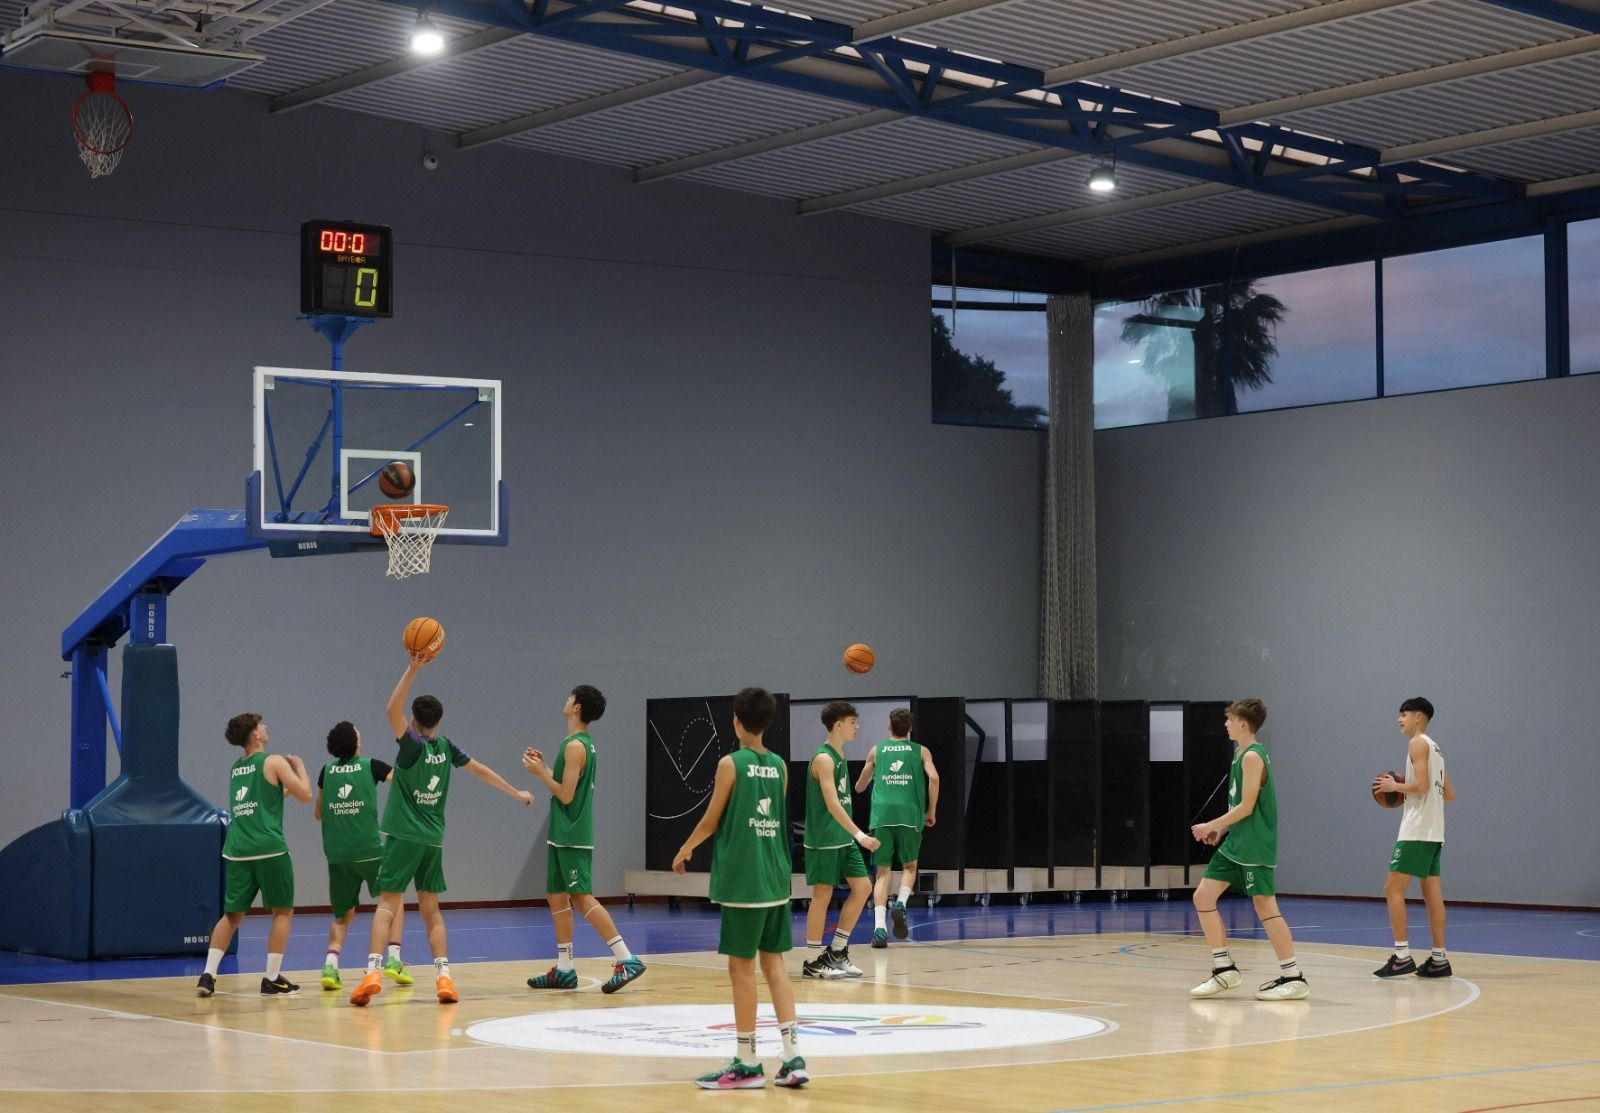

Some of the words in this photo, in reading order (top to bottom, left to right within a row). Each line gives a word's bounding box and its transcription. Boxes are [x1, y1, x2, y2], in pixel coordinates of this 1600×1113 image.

[320, 230, 365, 253] 00:0
[354, 267, 379, 307] 0
[148, 603, 156, 639] MONDO
[328, 799, 365, 810] Fundación
[183, 935, 210, 944] MOND
